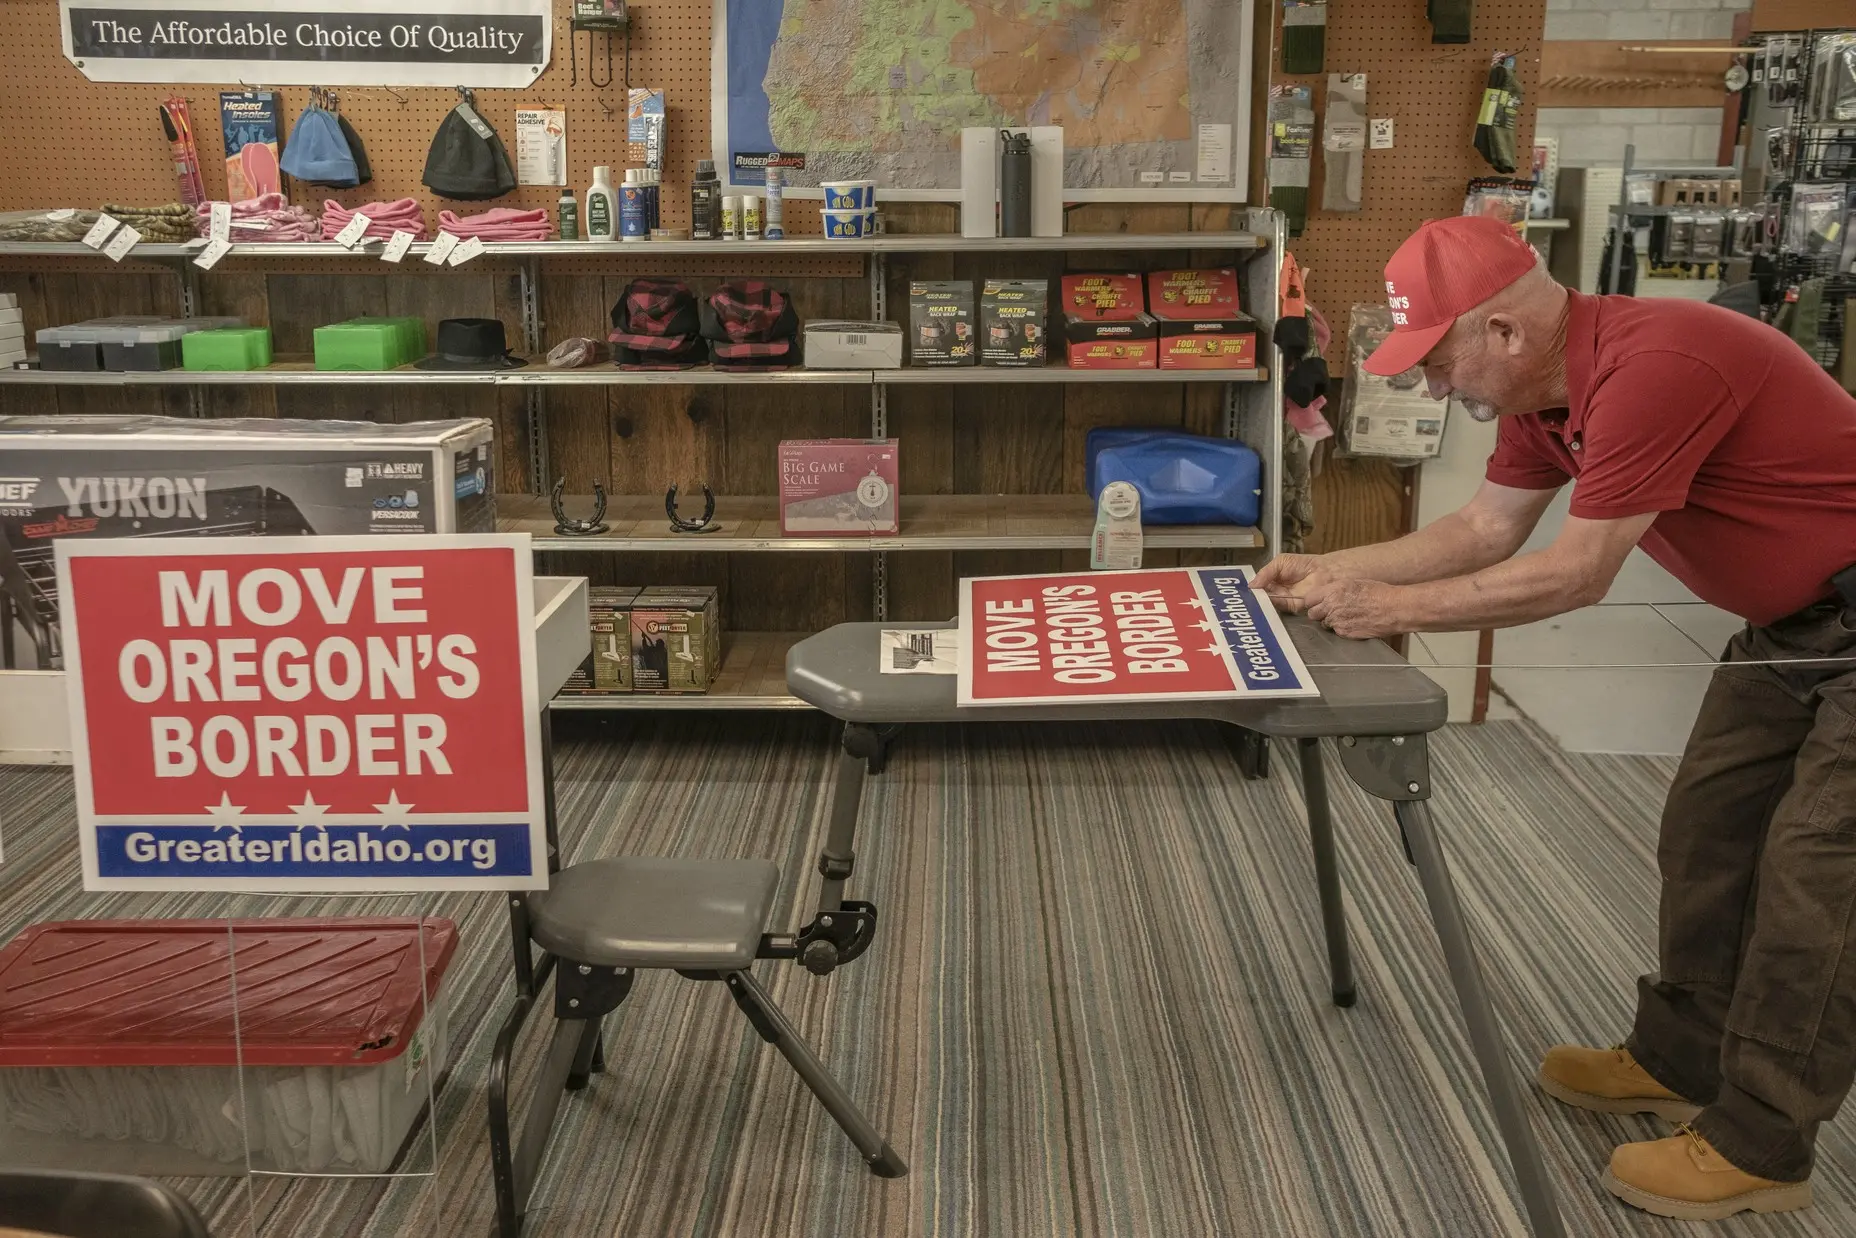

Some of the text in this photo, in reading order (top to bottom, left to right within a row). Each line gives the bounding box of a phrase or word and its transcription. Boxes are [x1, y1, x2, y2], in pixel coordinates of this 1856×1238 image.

[92, 20, 524, 54] The Affordable Choice Of Quality
[223, 101, 263, 111] Heated
[231, 111, 271, 119] Insoles
[736, 155, 804, 168] RUGGED MAPS
[1083, 278, 1104, 286] FOOT
[1172, 272, 1197, 280] FOOT
[1095, 300, 1116, 308] PIED
[1187, 295, 1211, 304] PIED
[1176, 340, 1196, 348] FOOT
[394, 463, 424, 474] HEAVY
[57, 476, 208, 519] YUKON
[159, 565, 429, 628] MOVE
[986, 598, 1041, 673] MOVE
[1041, 584, 1117, 685] OREGON'S
[1108, 588, 1190, 674] BORDER
[1213, 576, 1281, 682] GreaterIdaho.org
[119, 633, 481, 704] OREGON'S
[150, 713, 453, 779] BORDER
[125, 831, 497, 870] GreaterIdaho.org
